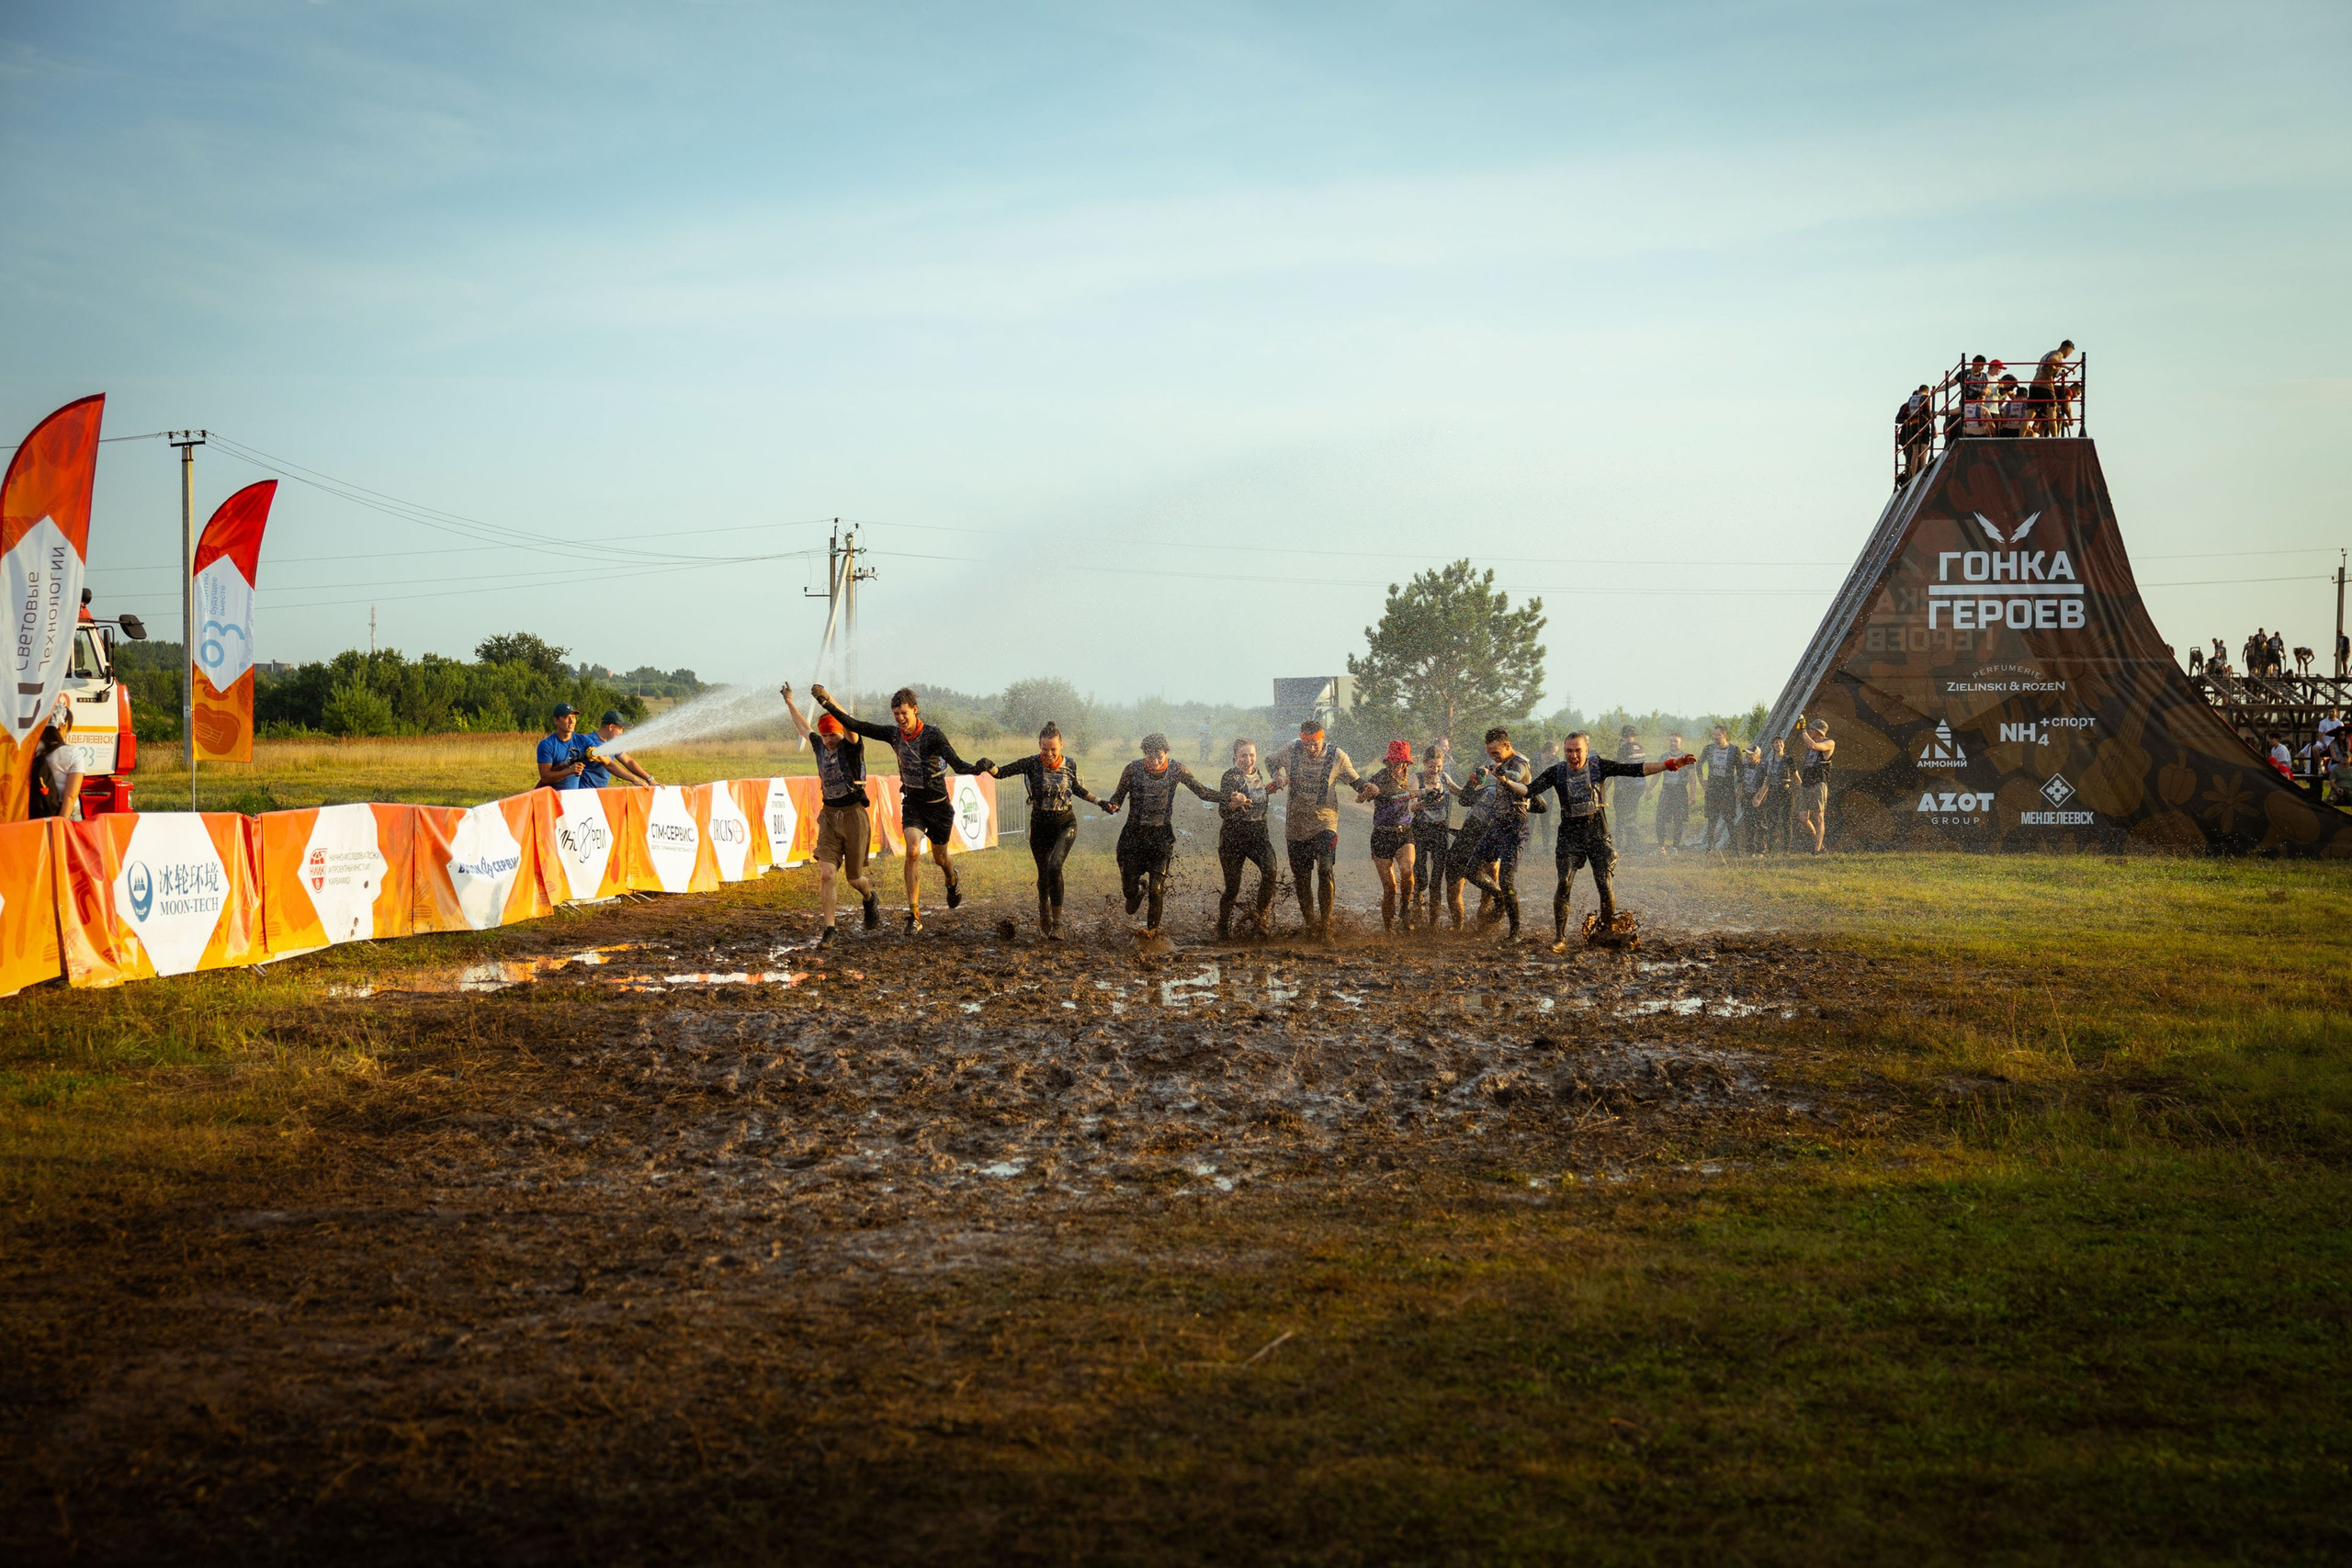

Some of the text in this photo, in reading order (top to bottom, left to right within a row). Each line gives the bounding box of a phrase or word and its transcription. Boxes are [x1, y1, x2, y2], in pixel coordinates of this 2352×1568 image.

[1939, 550, 2075, 581] ГОНКА
[209, 576, 219, 615] будущее
[1928, 599, 2086, 630] ГЕРОЕВ
[1972, 664, 2042, 680] PERFUMERIE
[1946, 681, 2066, 692] ZIELINSKI & ROZEN
[65, 734, 114, 744] НДЕЛЕЕВСК
[1917, 757, 1968, 768] АММОНИЙ
[1917, 792, 1995, 812] AZOT
[1931, 817, 1980, 825] GROUP
[2020, 811, 2095, 825] МЕНДЕЛЕЕВСК
[650, 823, 695, 842] СТМ-СЕРВИС
[159, 861, 220, 897] 冰轮环境
[160, 897, 220, 916] MOON-TECH
